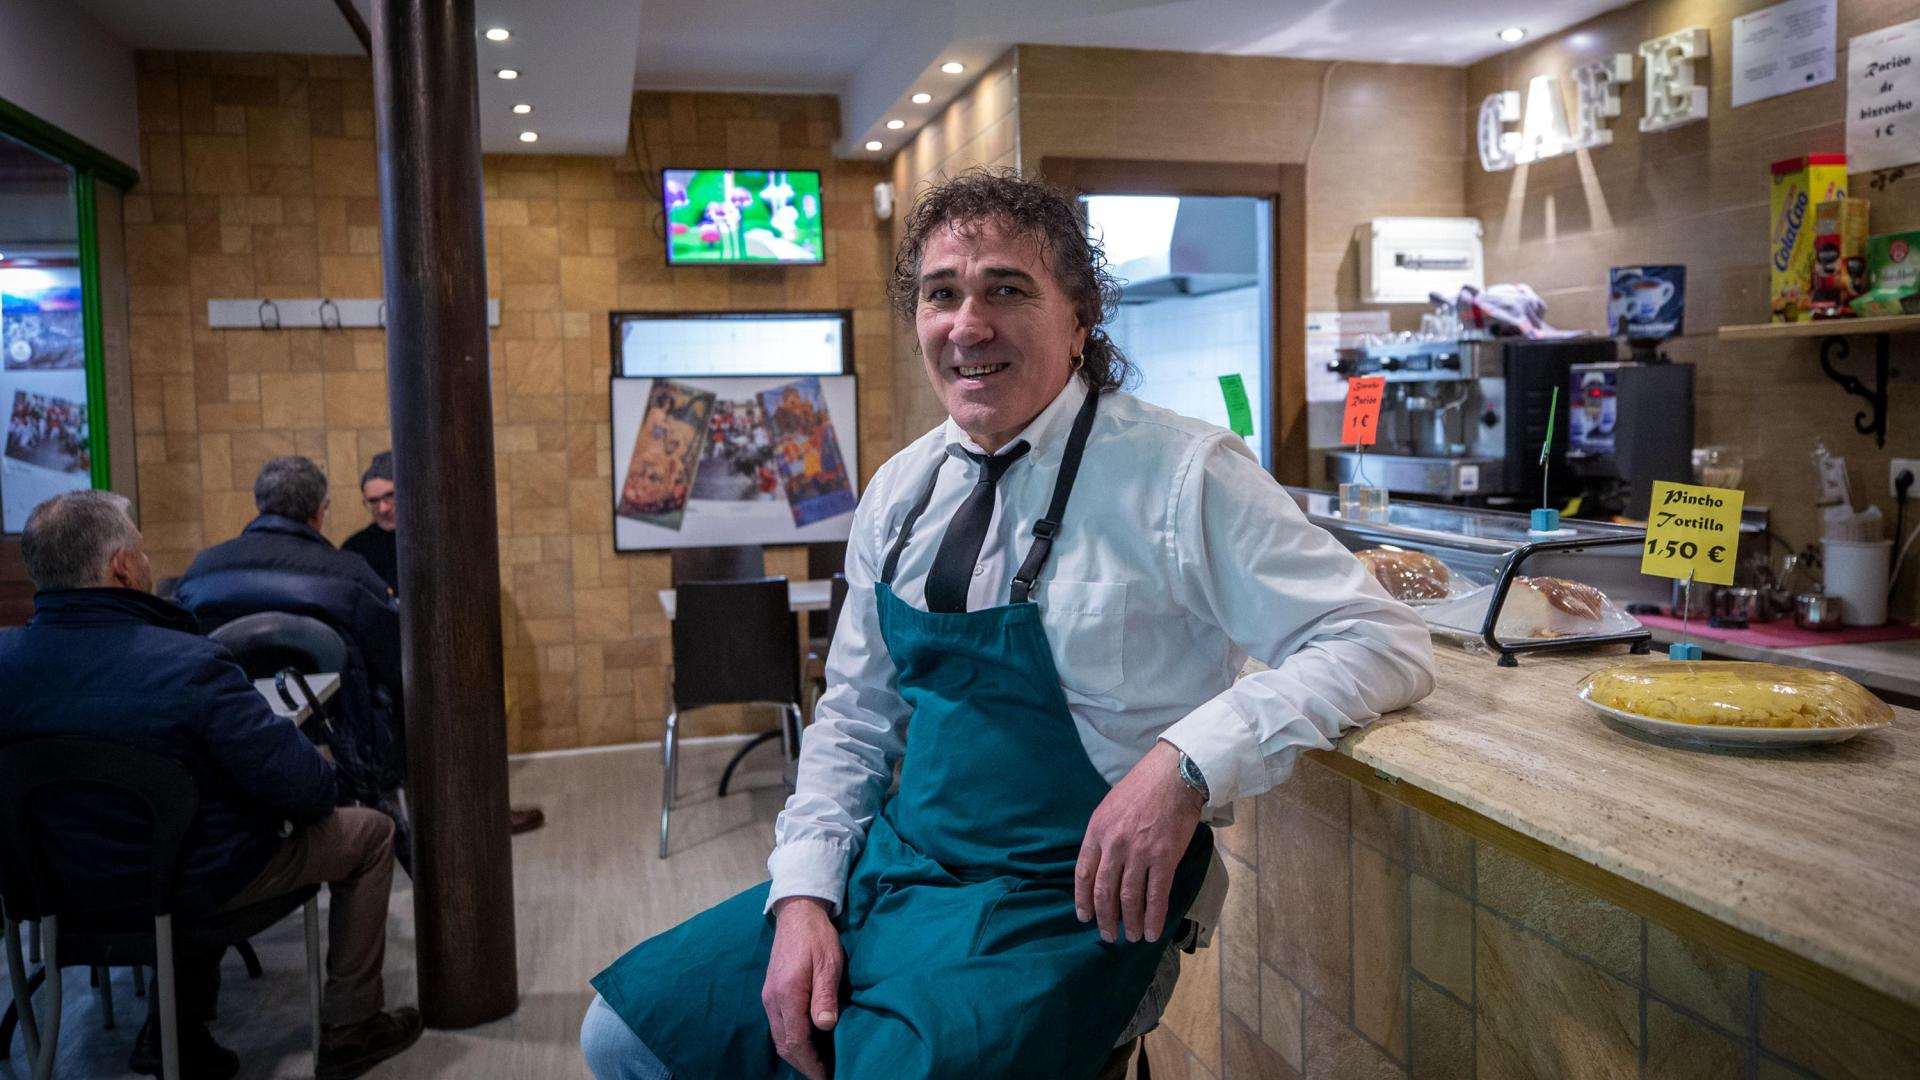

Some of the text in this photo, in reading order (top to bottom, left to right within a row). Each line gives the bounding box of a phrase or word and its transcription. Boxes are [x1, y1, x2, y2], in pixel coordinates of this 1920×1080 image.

[1880, 80, 1894, 93] de
[1477, 28, 1709, 172] CAFE
[1775, 191, 1809, 272] ColaCao
[1663, 489, 1724, 508] Pincho
[1656, 511, 1724, 532] Tortilla
[1647, 538, 1727, 564] 1,50 €
